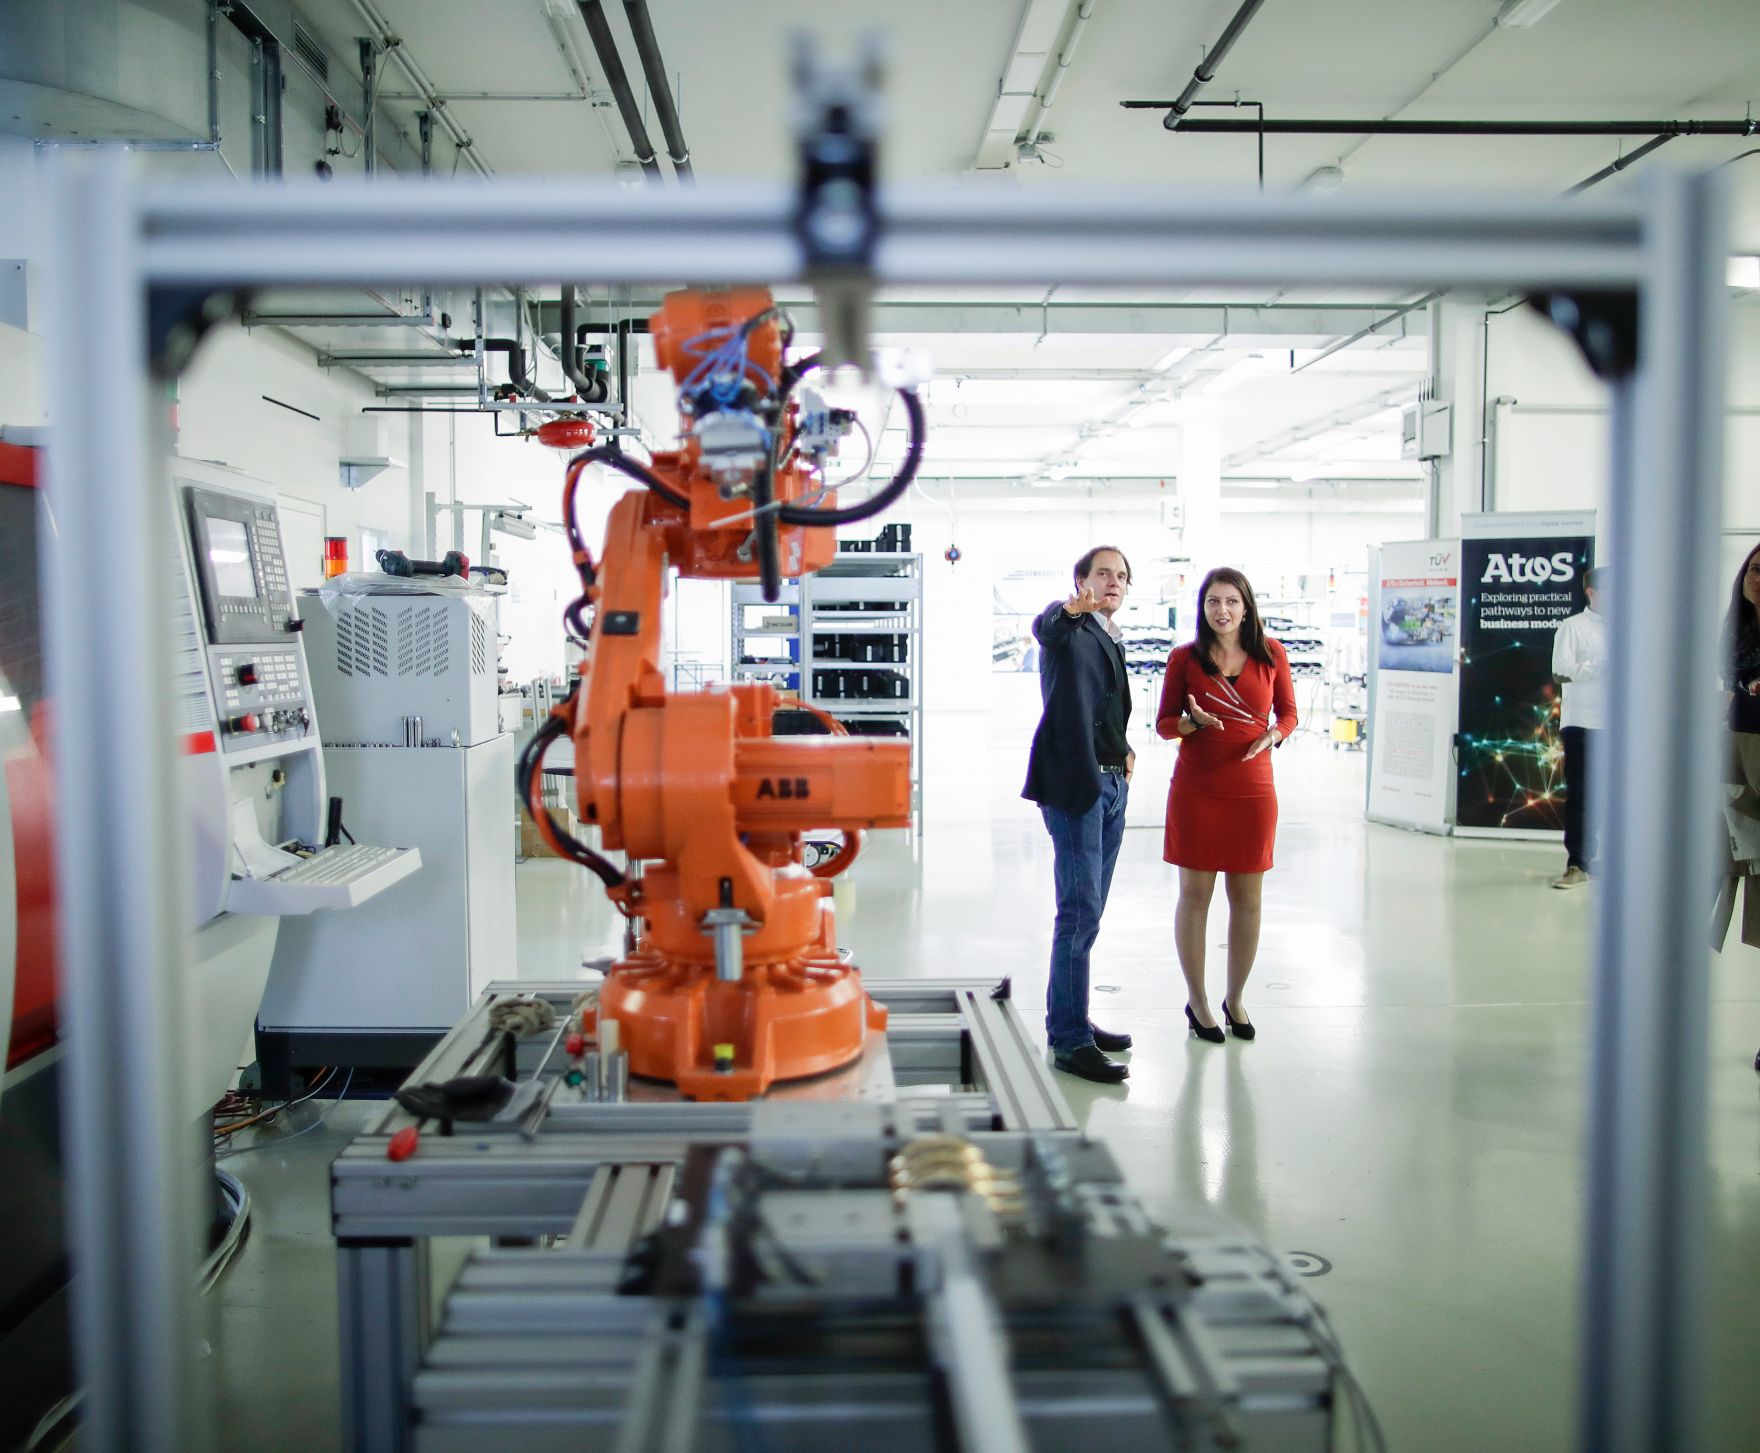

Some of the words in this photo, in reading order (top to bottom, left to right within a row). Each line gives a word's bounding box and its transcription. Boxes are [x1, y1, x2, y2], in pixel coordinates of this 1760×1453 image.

[1481, 592, 1528, 604] Exploring
[1529, 592, 1572, 604] practical
[1481, 605, 1532, 617] pathways
[1534, 605, 1546, 615] to
[1547, 606, 1572, 615] new
[1480, 618, 1529, 629] business
[1530, 618, 1565, 629] mode
[756, 777, 810, 800] ABB
